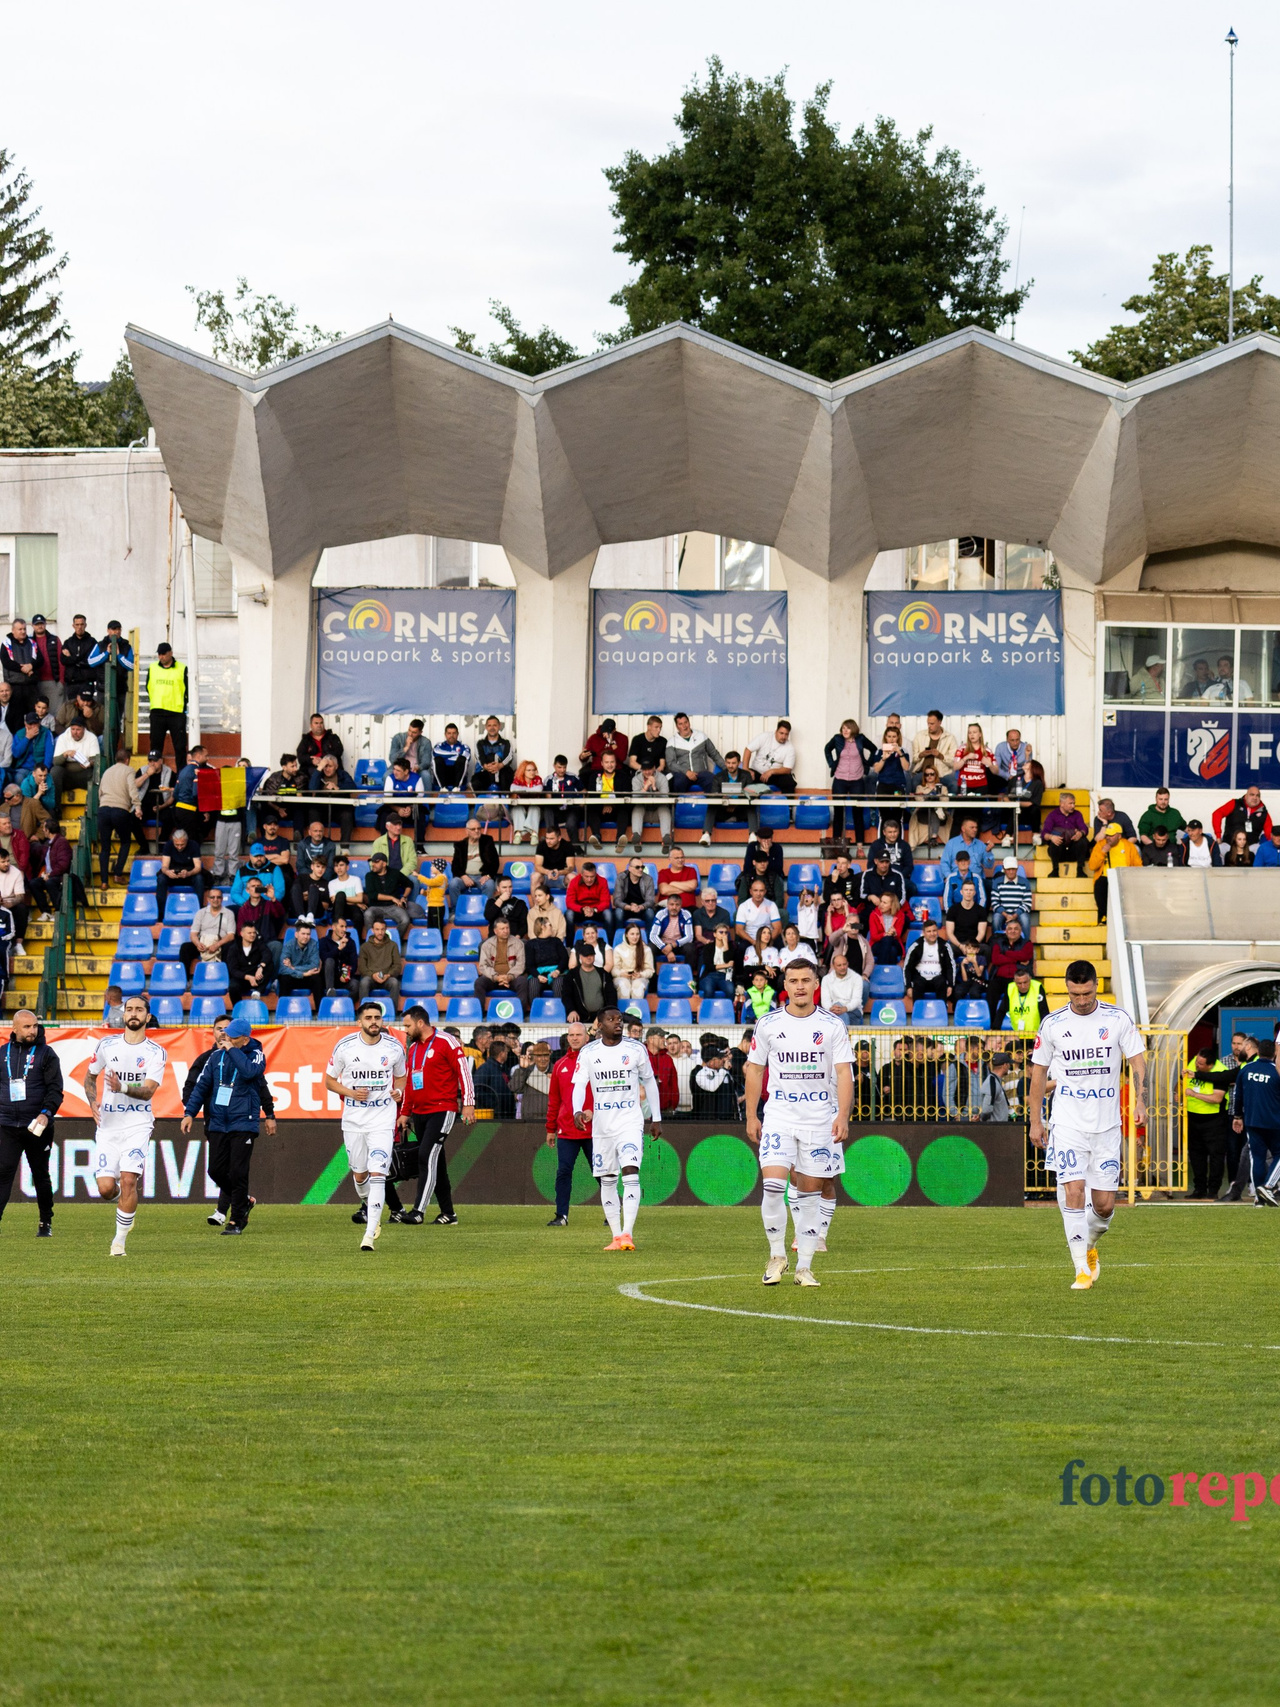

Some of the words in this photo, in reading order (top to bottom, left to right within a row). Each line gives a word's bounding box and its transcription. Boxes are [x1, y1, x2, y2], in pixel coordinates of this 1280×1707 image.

[322, 600, 510, 646] CORNIȘA
[598, 601, 786, 647] CORNIȘA
[873, 601, 1060, 647] CORNIȘA
[322, 648, 420, 666] aquapark
[430, 648, 442, 662] &
[452, 648, 510, 666] sports
[598, 648, 696, 666] aquapark
[706, 650, 718, 664] &
[727, 650, 786, 666] sports
[874, 648, 971, 666] aquapark
[980, 649, 992, 663] &
[1002, 648, 1060, 666] sports
[1063, 864, 1069, 876] 7
[1061, 896, 1068, 908] 6
[1063, 929, 1070, 941] 5
[19, 994, 26, 1006] 3
[78, 995, 85, 1007] 3
[778, 1052, 824, 1062] UNIBET
[1062, 1047, 1112, 1060] UNIBET
[352, 1070, 390, 1079] UNIBET
[594, 1070, 632, 1080] UNIBET
[1247, 1072, 1270, 1083] FCBT
[775, 1090, 828, 1102] ELSACO
[1061, 1086, 1115, 1099] ELSACO
[595, 1100, 634, 1110] ELSACO
[762, 1133, 781, 1150] 33
[99, 1154, 107, 1167] 8
[1058, 1149, 1077, 1169] 30
